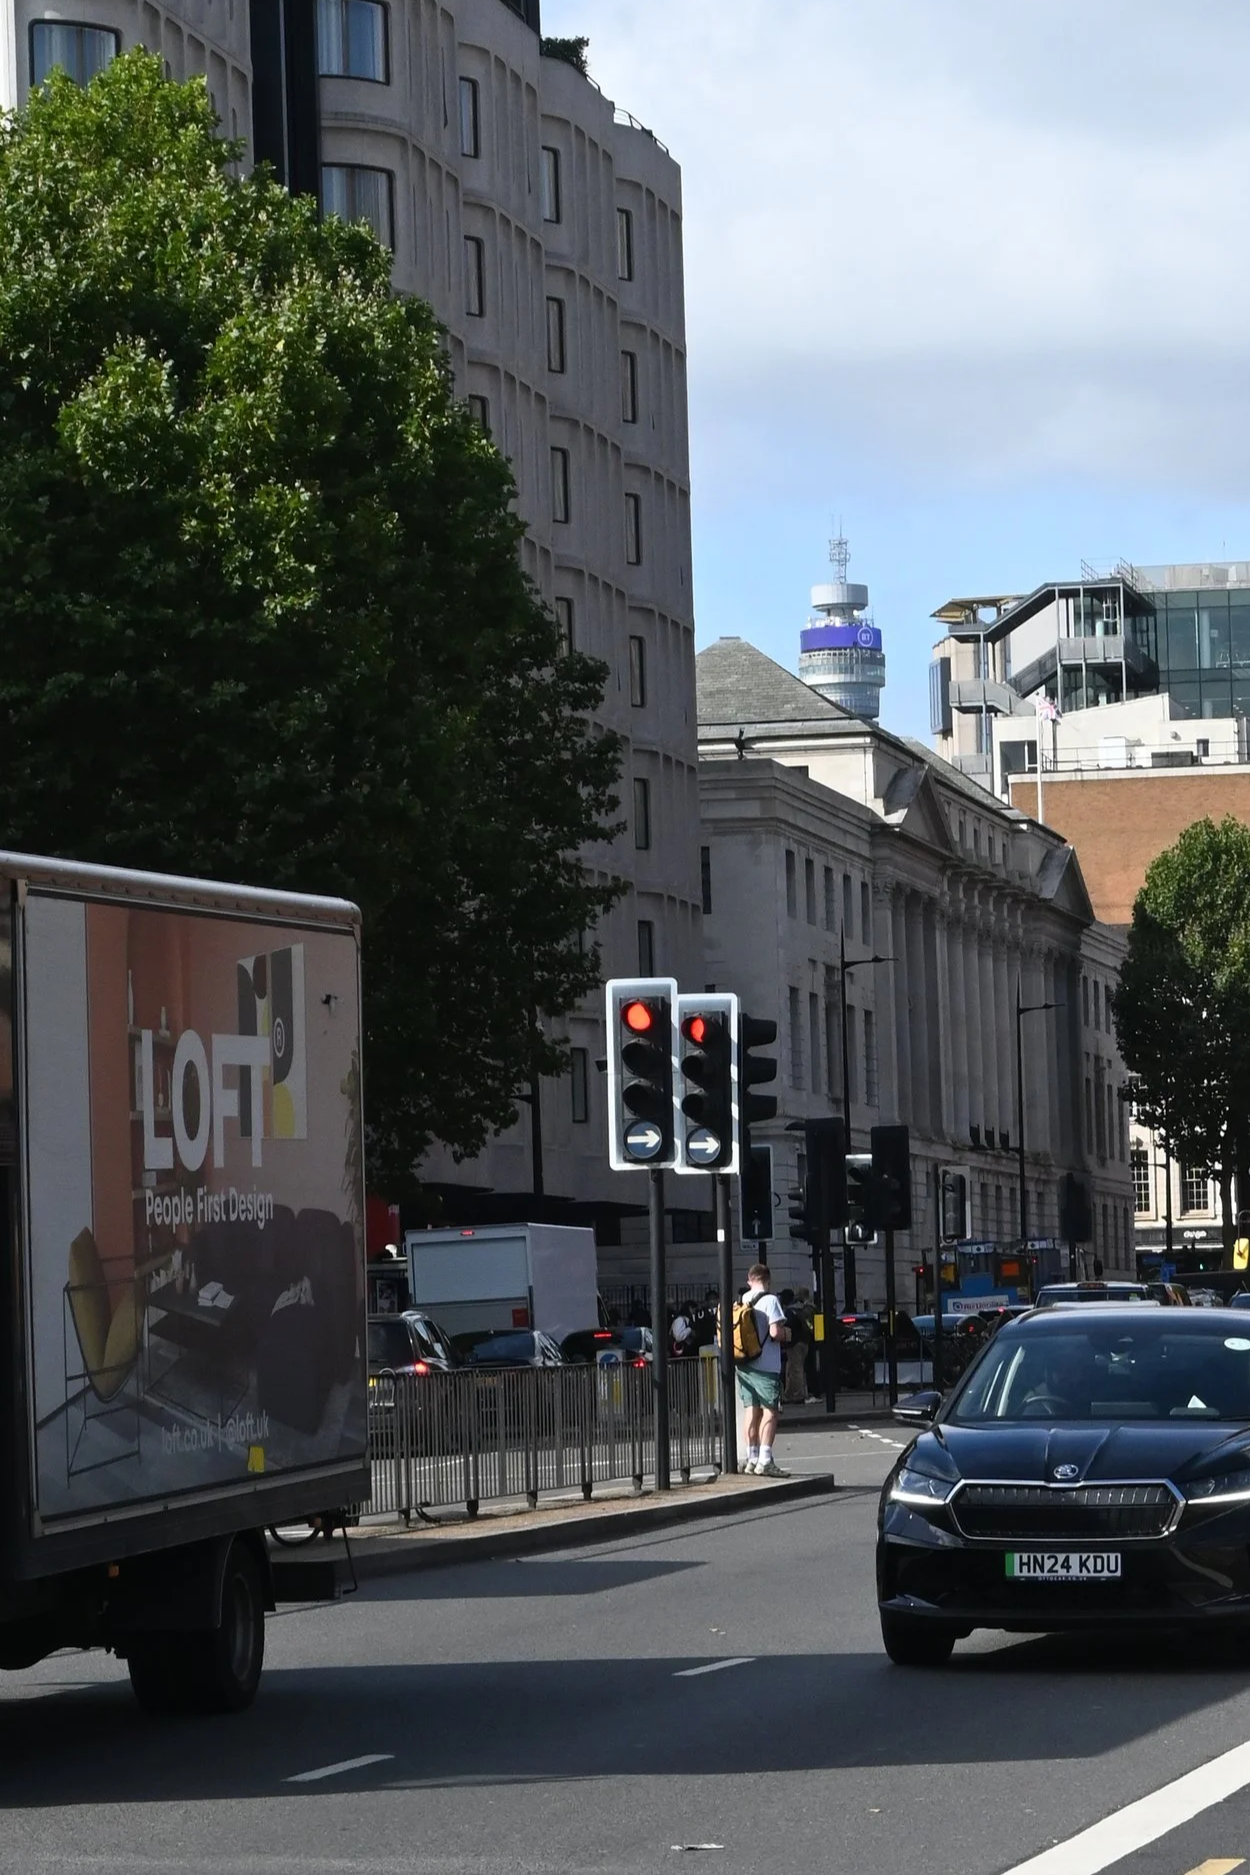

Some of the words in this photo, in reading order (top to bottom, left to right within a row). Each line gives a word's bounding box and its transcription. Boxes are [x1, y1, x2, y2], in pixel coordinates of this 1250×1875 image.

[141, 1029, 271, 1171] LOFT
[145, 1187, 194, 1234] People
[197, 1185, 226, 1223] First
[229, 1185, 274, 1230] Design
[161, 1418, 214, 1455] loft.co.uk
[225, 1408, 270, 1451] @loft.uk
[1019, 1555, 1072, 1574] HN24
[1079, 1554, 1119, 1574] KDU
